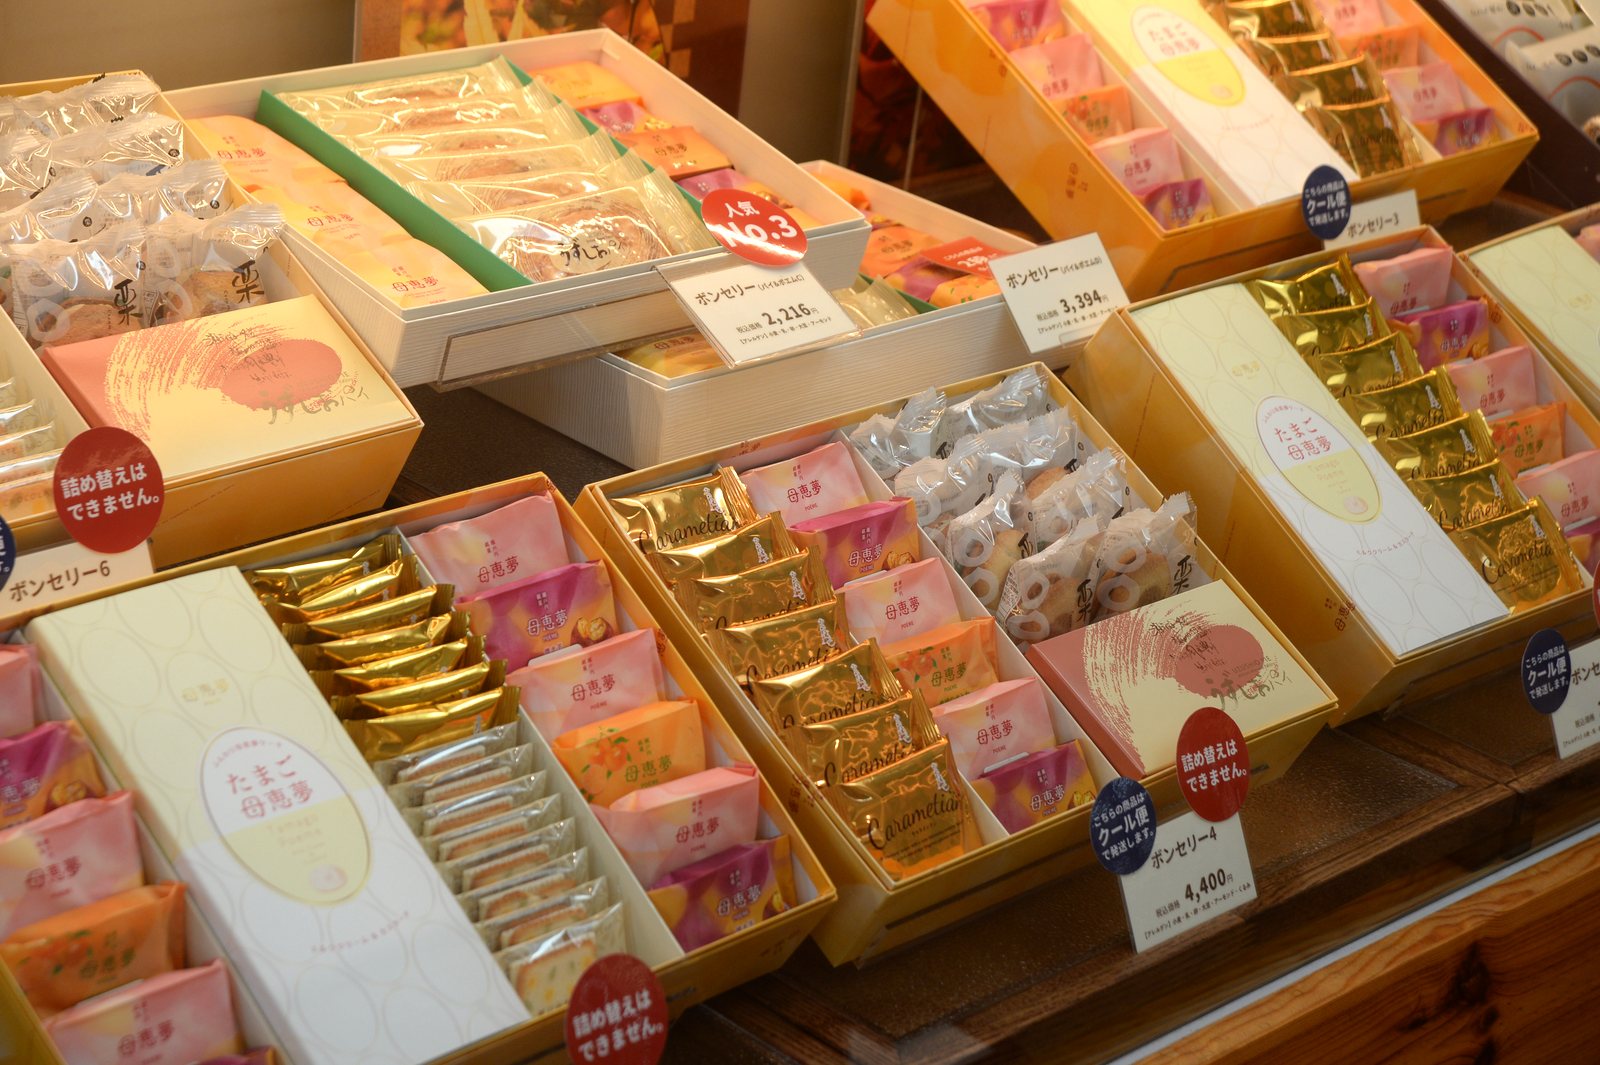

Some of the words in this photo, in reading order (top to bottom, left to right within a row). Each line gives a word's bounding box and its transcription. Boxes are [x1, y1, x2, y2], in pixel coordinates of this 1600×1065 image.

[725, 200, 760, 219] 人気
[1306, 190, 1347, 215] クール便
[717, 215, 798, 248] No.3
[231, 260, 265, 303] 栗
[1006, 265, 1059, 289] ボンセリー
[114, 278, 143, 326] 栗
[695, 284, 756, 306] ボンセリー
[1287, 435, 1331, 461] 母恵夢
[60, 462, 148, 499] 詰め替えは
[787, 479, 822, 503] 母恵夢
[67, 488, 160, 521] できません。
[1561, 495, 1590, 517] 母恵夢
[848, 543, 883, 567] 母恵夢
[9, 560, 111, 602] ボンセリー6
[477, 556, 519, 583] 母恵夢
[886, 596, 920, 620] 母恵夢
[528, 609, 568, 636] 母恵夢
[1525, 644, 1565, 669] こちらの商品は
[931, 661, 967, 687] 母恵夢
[1527, 656, 1567, 687] クール便
[570, 673, 616, 701] 母恵夢
[1529, 676, 1569, 700] で発送します。
[976, 719, 1013, 745] 母恵夢
[624, 755, 672, 783] 母恵夢
[1180, 738, 1238, 773] 詰め替えは
[1186, 762, 1247, 794] できません。
[241, 779, 313, 819] 母恵夢
[1030, 784, 1065, 811] 母恵夢
[1092, 791, 1145, 828] こちらの商品は
[675, 817, 720, 844] 母恵夢
[1097, 805, 1150, 848] クール便
[1101, 828, 1155, 861] で発送します。
[1151, 826, 1217, 870] ボンセリー4
[717, 885, 761, 916] 母恵夢
[1155, 900, 1181, 919] 税込価格
[572, 987, 653, 1039] 詰め替えは
[577, 1016, 665, 1063] できません。
